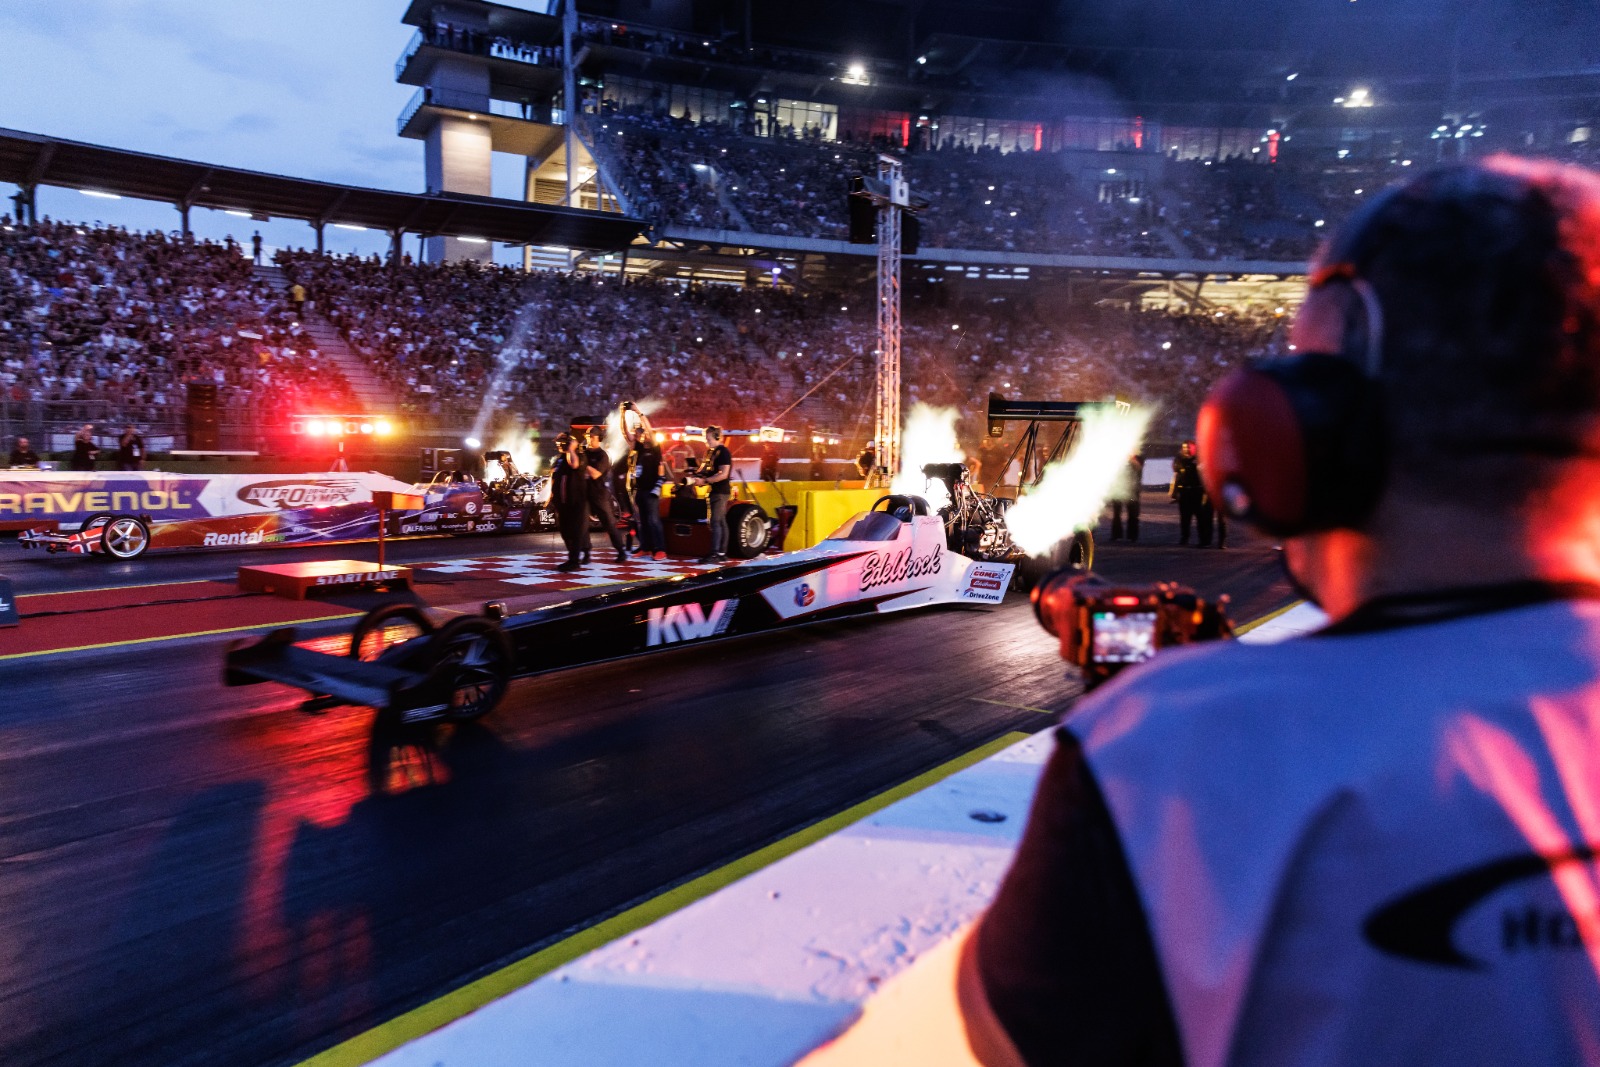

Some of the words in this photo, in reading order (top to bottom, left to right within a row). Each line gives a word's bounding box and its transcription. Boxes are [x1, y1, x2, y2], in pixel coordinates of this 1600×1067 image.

[0, 491, 192, 513] RAVENOL
[316, 573, 363, 585] START
[366, 570, 399, 581] LINE
[860, 543, 942, 592] Edelbrock
[969, 591, 1000, 601] DriveZone
[646, 599, 729, 647] KW
